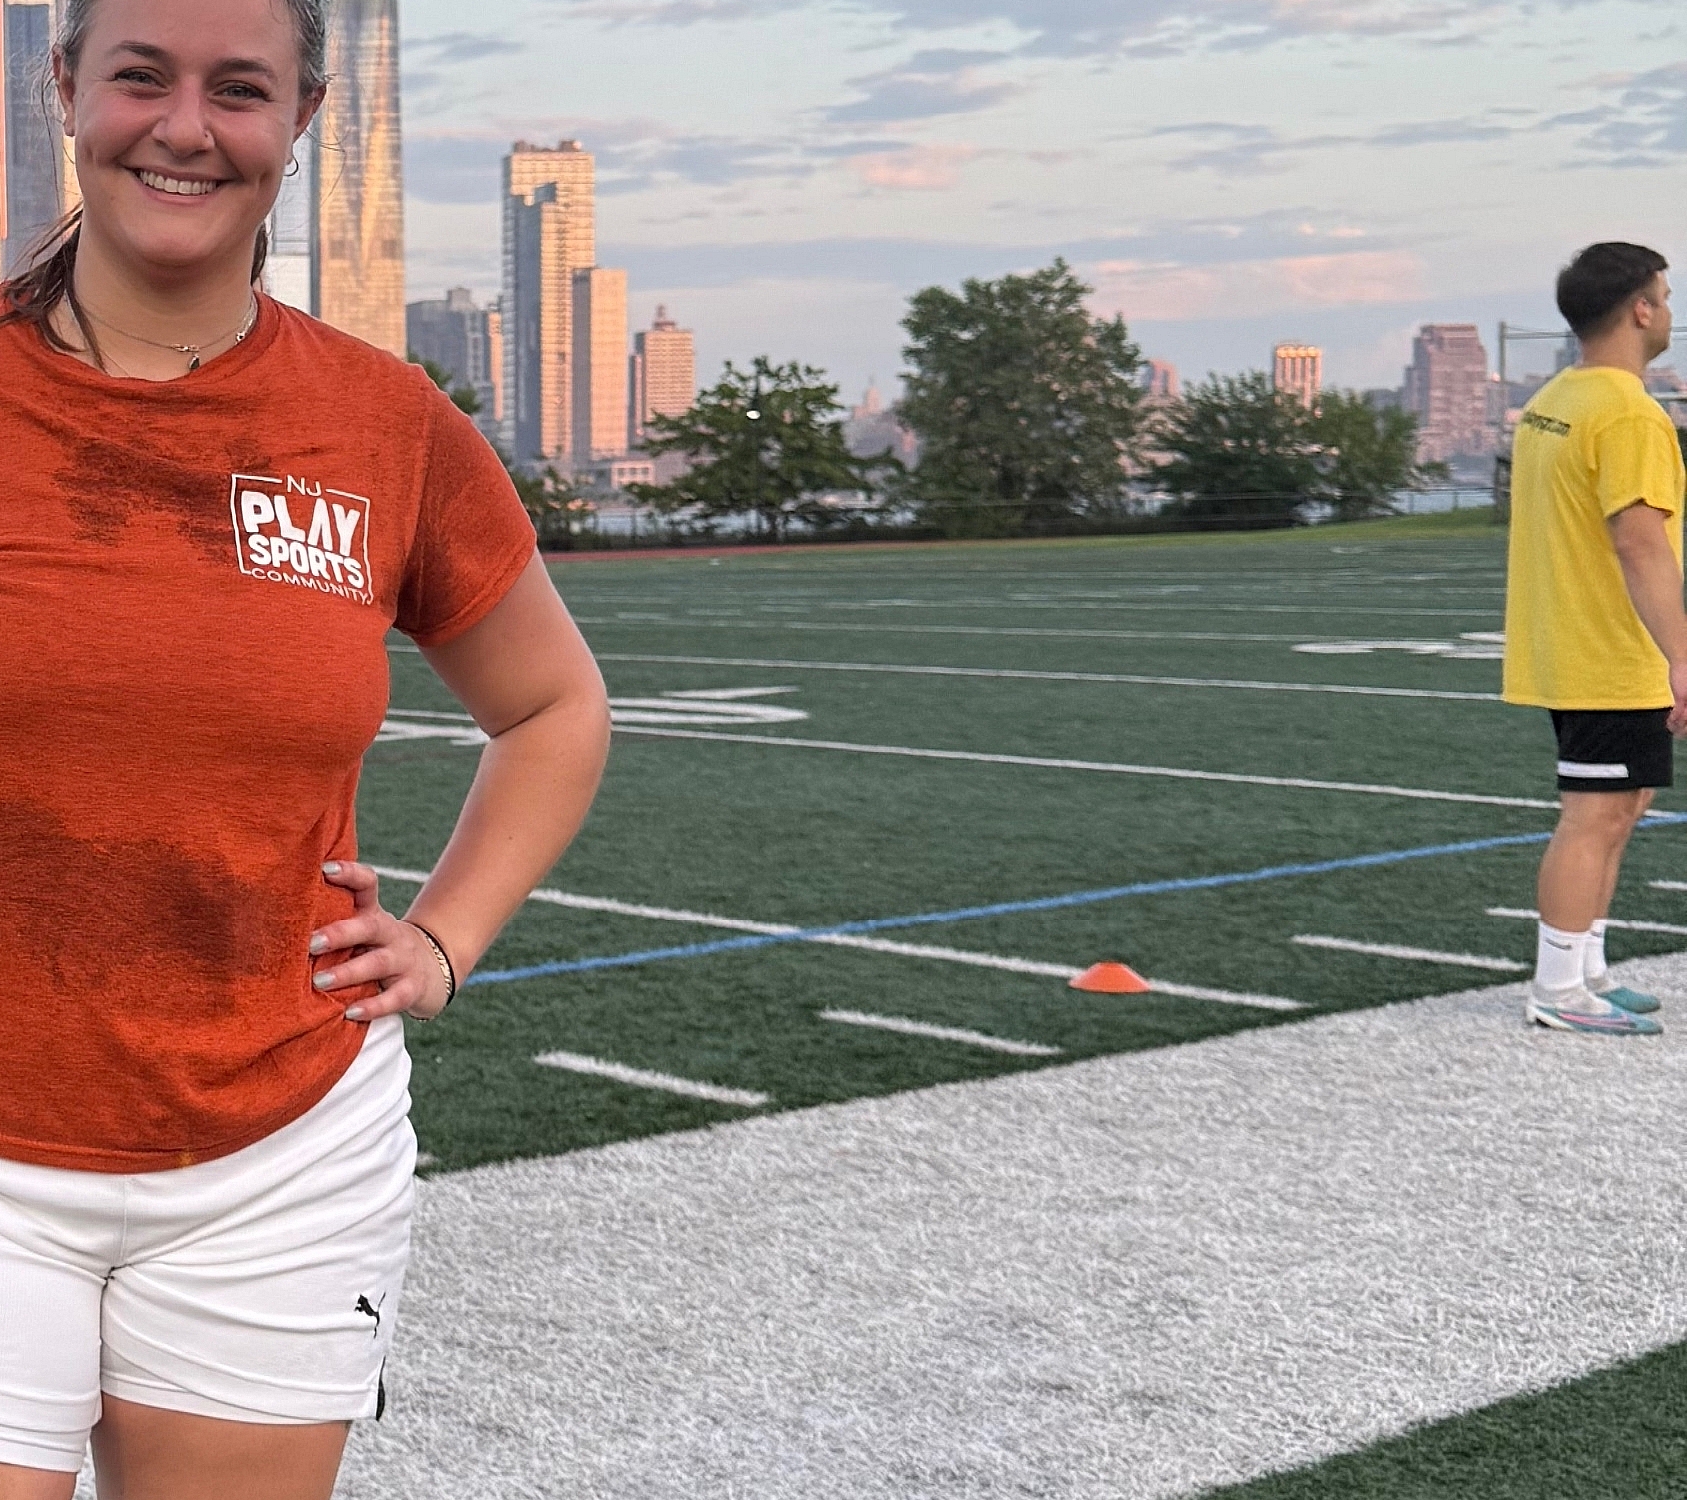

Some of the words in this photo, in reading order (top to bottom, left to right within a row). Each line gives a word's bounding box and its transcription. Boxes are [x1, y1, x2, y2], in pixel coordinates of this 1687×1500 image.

[286, 474, 322, 497] NJ
[241, 490, 361, 557] PLAY
[248, 534, 365, 589] SPORTS
[251, 567, 369, 605] COMMUNITY
